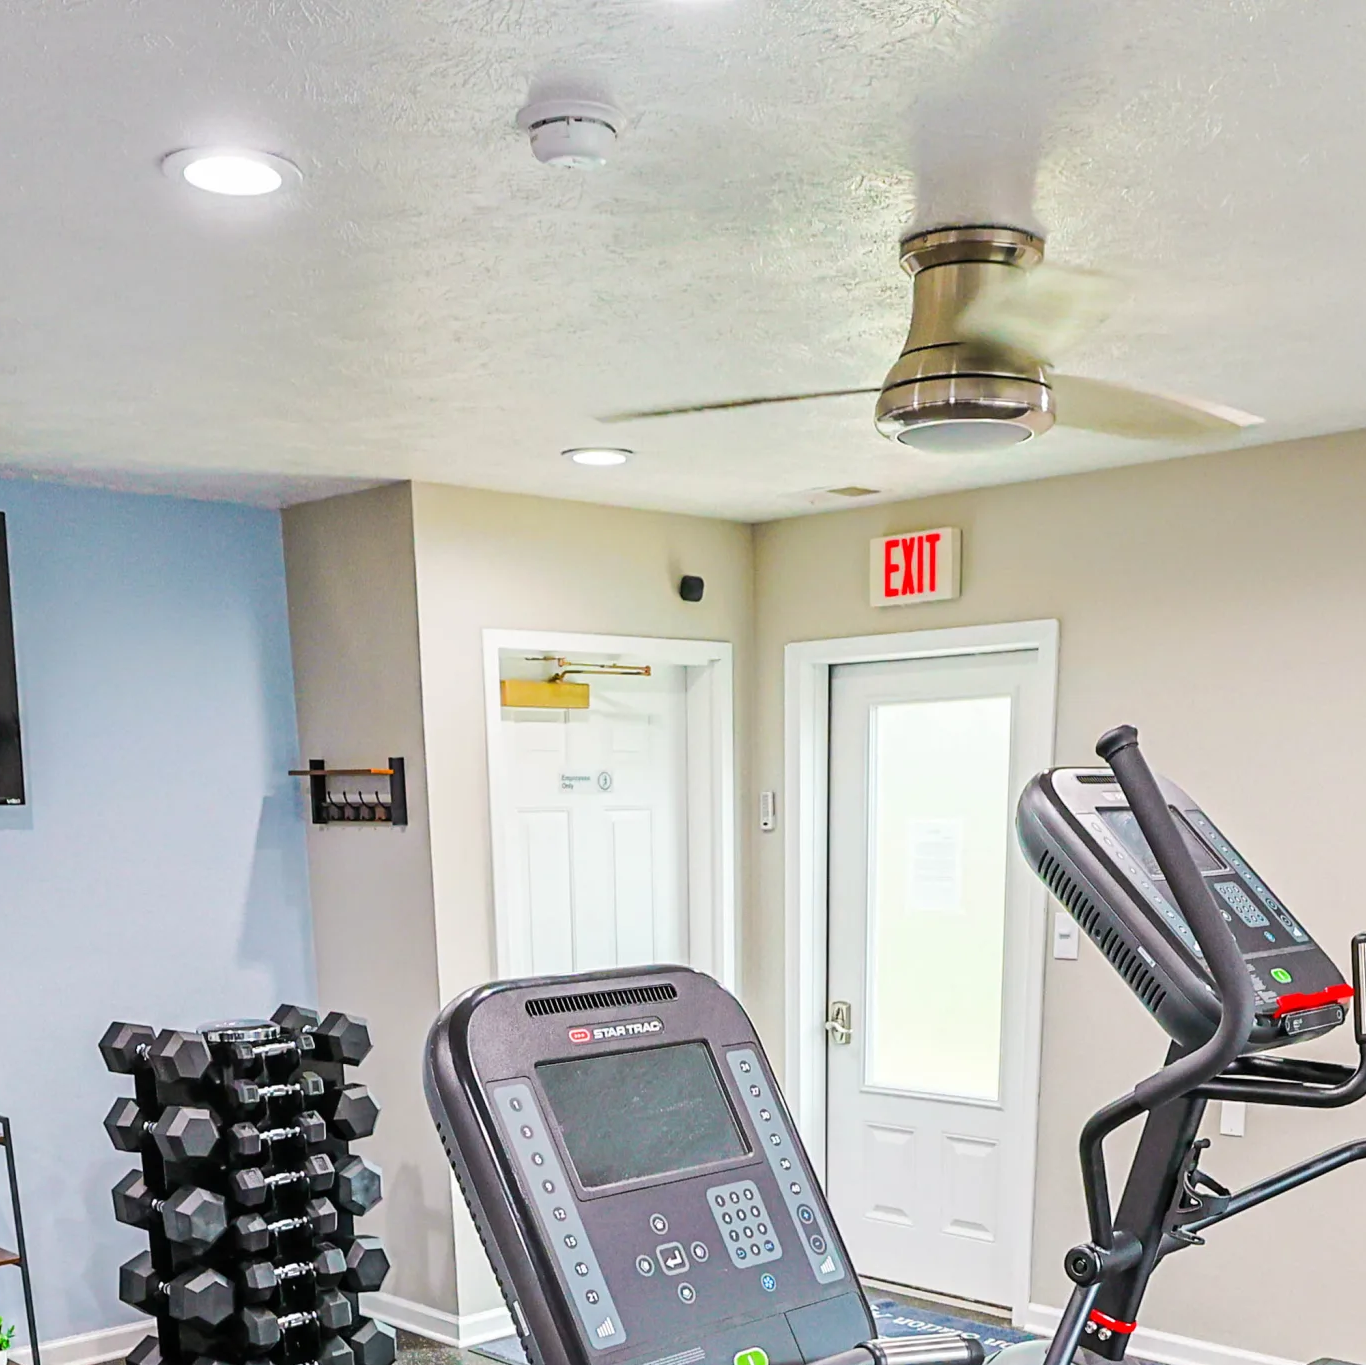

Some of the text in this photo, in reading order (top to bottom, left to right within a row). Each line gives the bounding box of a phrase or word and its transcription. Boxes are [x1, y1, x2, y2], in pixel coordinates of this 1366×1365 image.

[884, 533, 941, 597] EXIT
[593, 1021, 661, 1039] STAR TRAC
[512, 1100, 520, 1109] 1
[523, 1127, 531, 1137] 3
[534, 1155, 542, 1164] 6
[544, 1182, 552, 1191] 9
[554, 1209, 566, 1219] 12
[564, 1236, 577, 1247] 15
[575, 1264, 588, 1275] 18
[586, 1292, 599, 1302] 21
